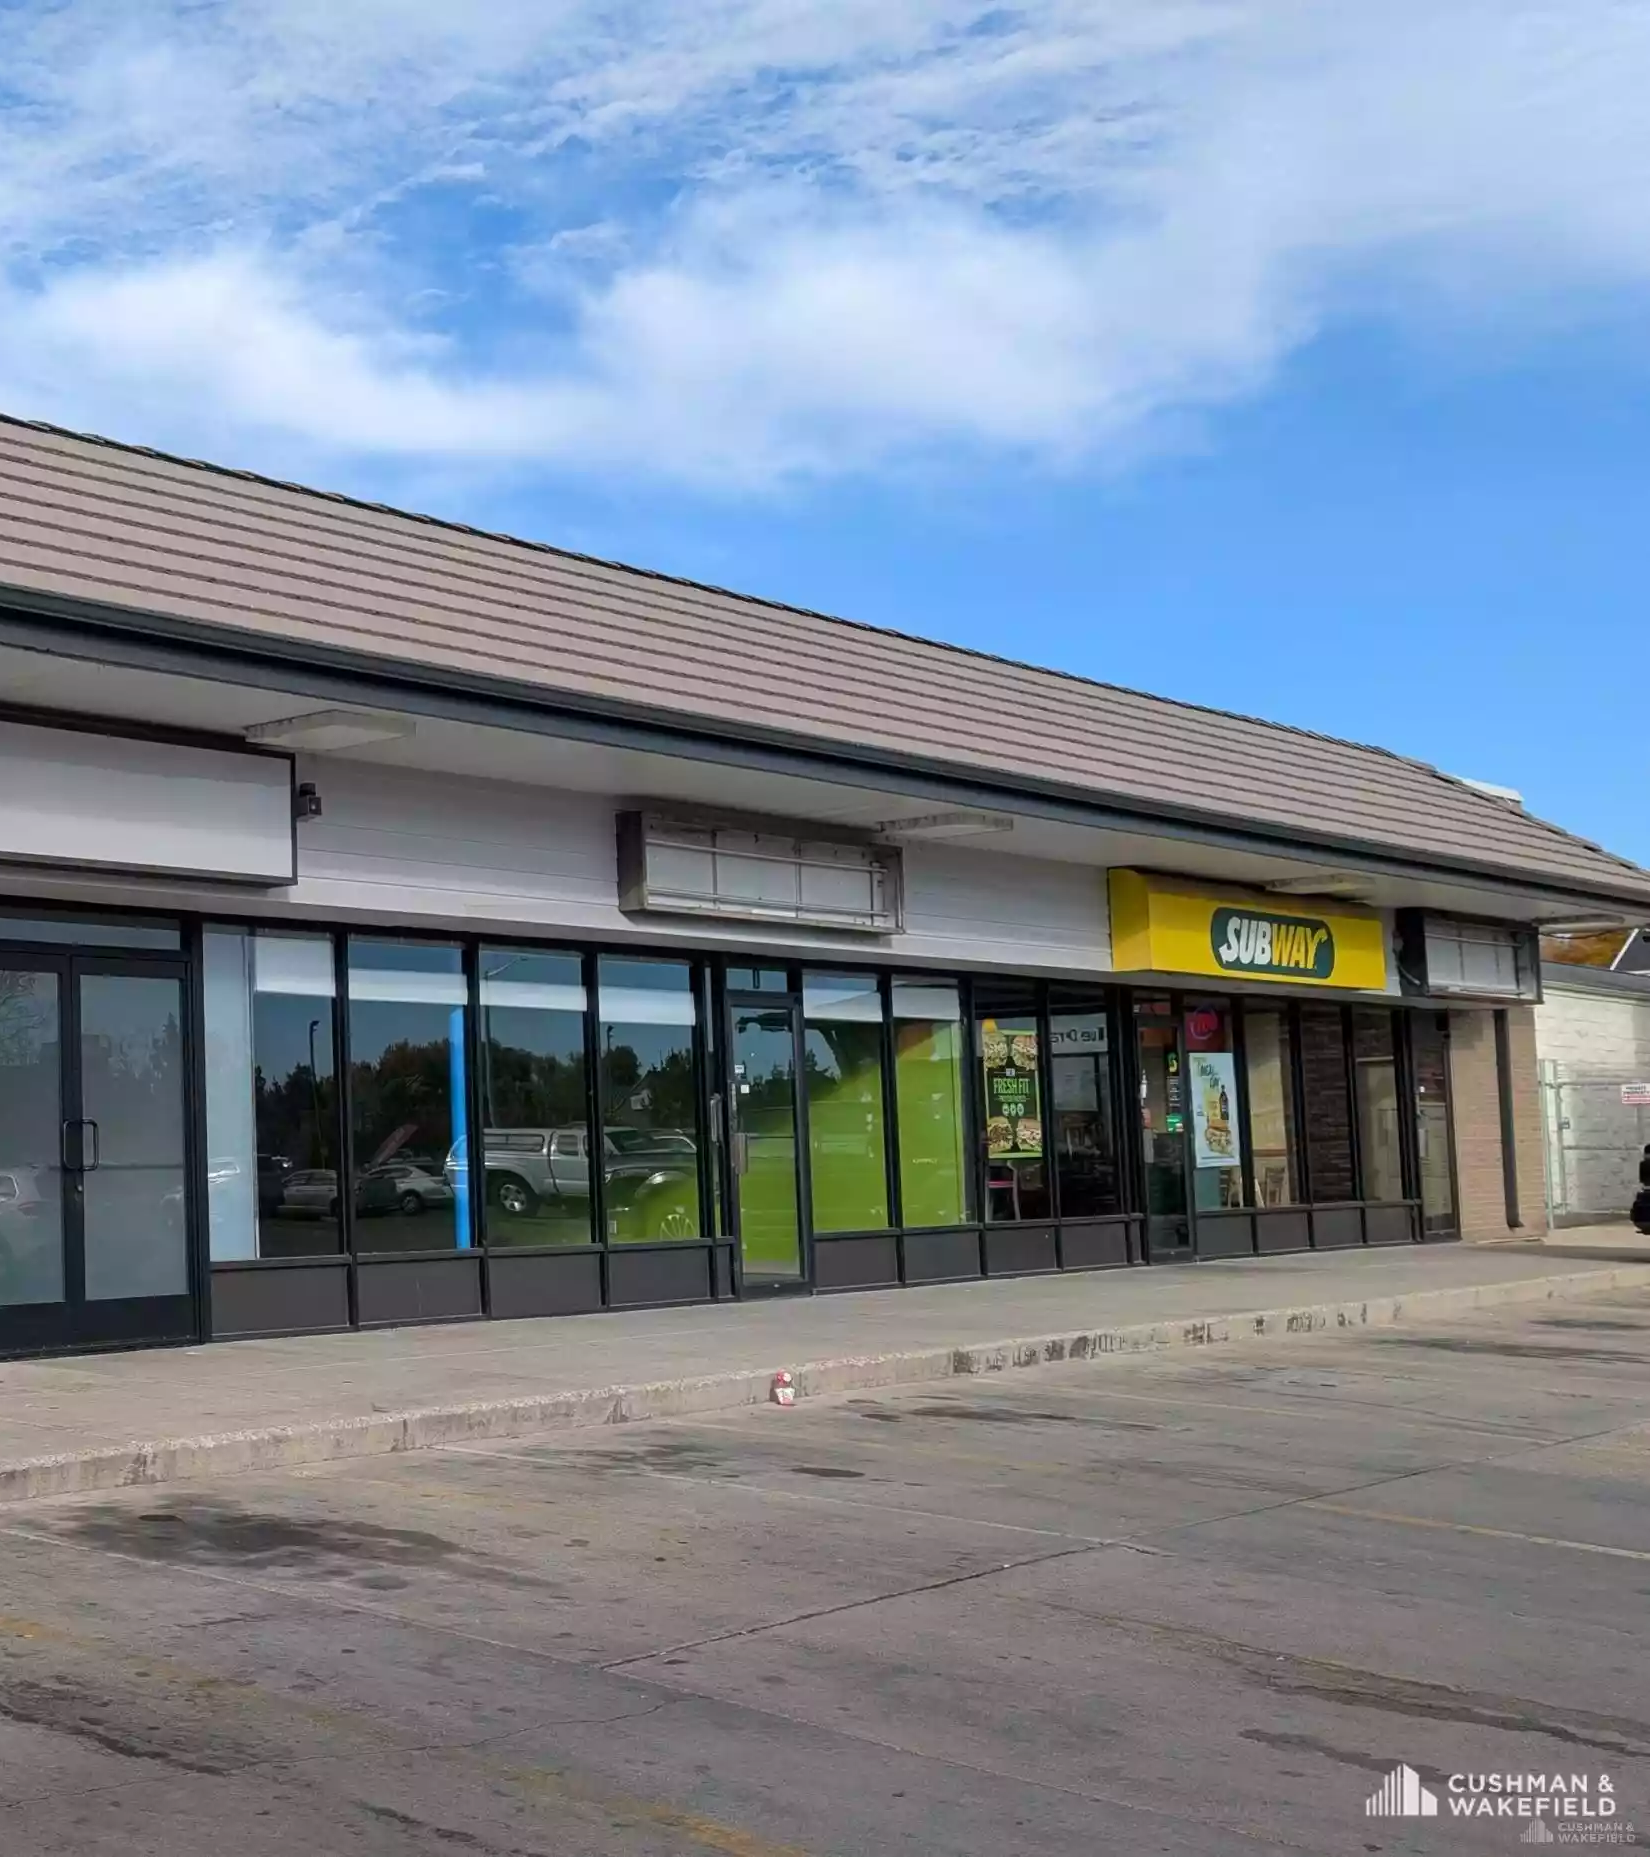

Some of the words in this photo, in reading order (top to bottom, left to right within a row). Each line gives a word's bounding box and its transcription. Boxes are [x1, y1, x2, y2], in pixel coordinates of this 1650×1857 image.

[1218, 916, 1329, 970] SUBWAY
[993, 1077, 1017, 1094] FRESH
[1019, 1077, 1030, 1094] FIT
